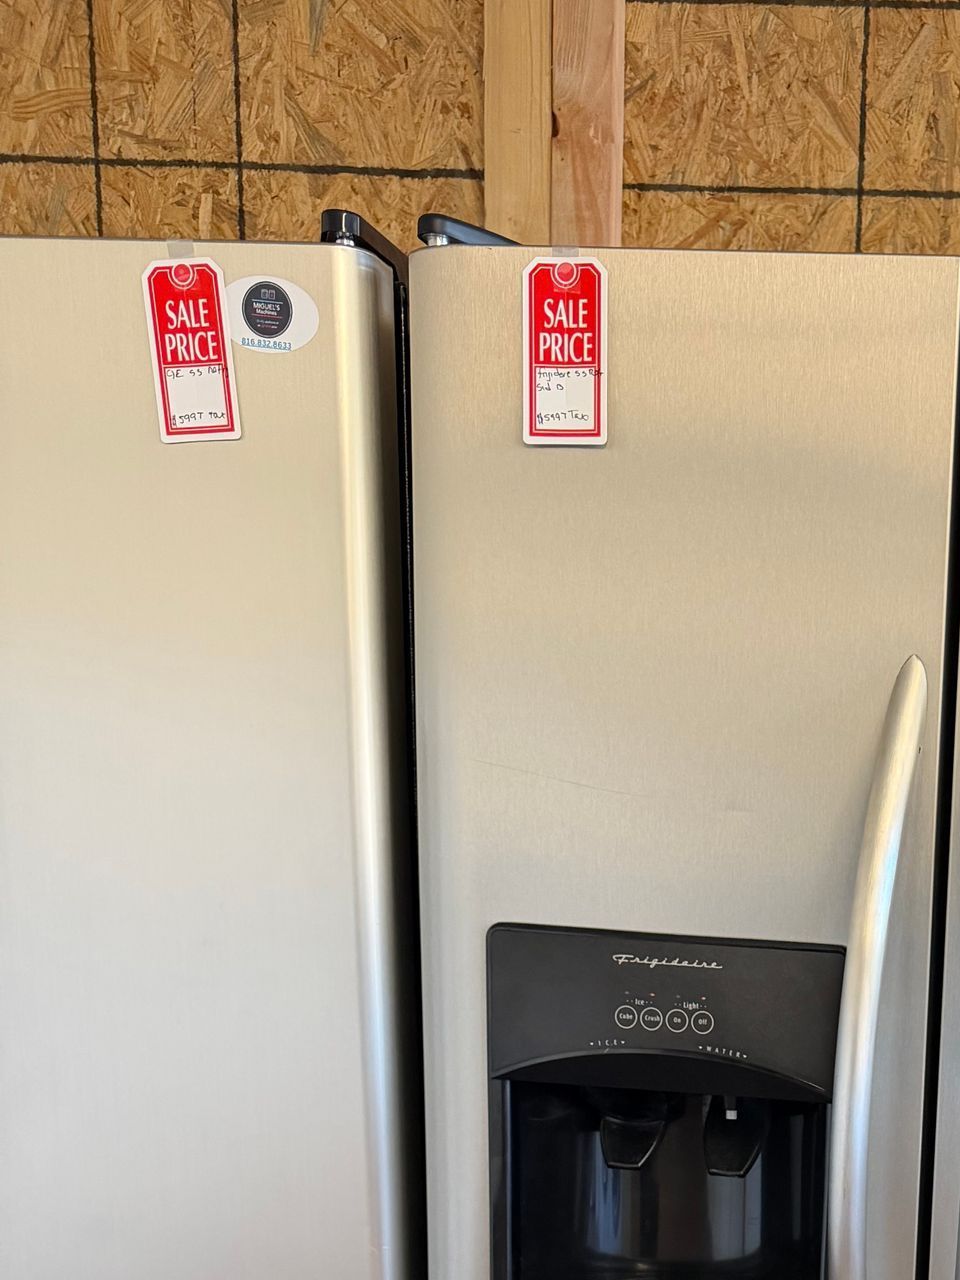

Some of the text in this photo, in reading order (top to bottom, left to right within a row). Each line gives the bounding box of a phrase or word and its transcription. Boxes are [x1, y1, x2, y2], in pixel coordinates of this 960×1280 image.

[252, 302, 280, 312] MIGUEL'S
[543, 298, 588, 329] SALE
[165, 298, 210, 330] SALE
[165, 331, 219, 362] PRICE
[241, 337, 292, 350] 816.832.8633
[539, 332, 593, 363] PRICE
[612, 954, 724, 969] Frigidaire
[635, 998, 645, 1006] Ice
[683, 1002, 700, 1010] Light
[619, 1012, 633, 1020] Cube
[644, 1014, 661, 1022] Crush
[706, 1045, 741, 1058] WATER
